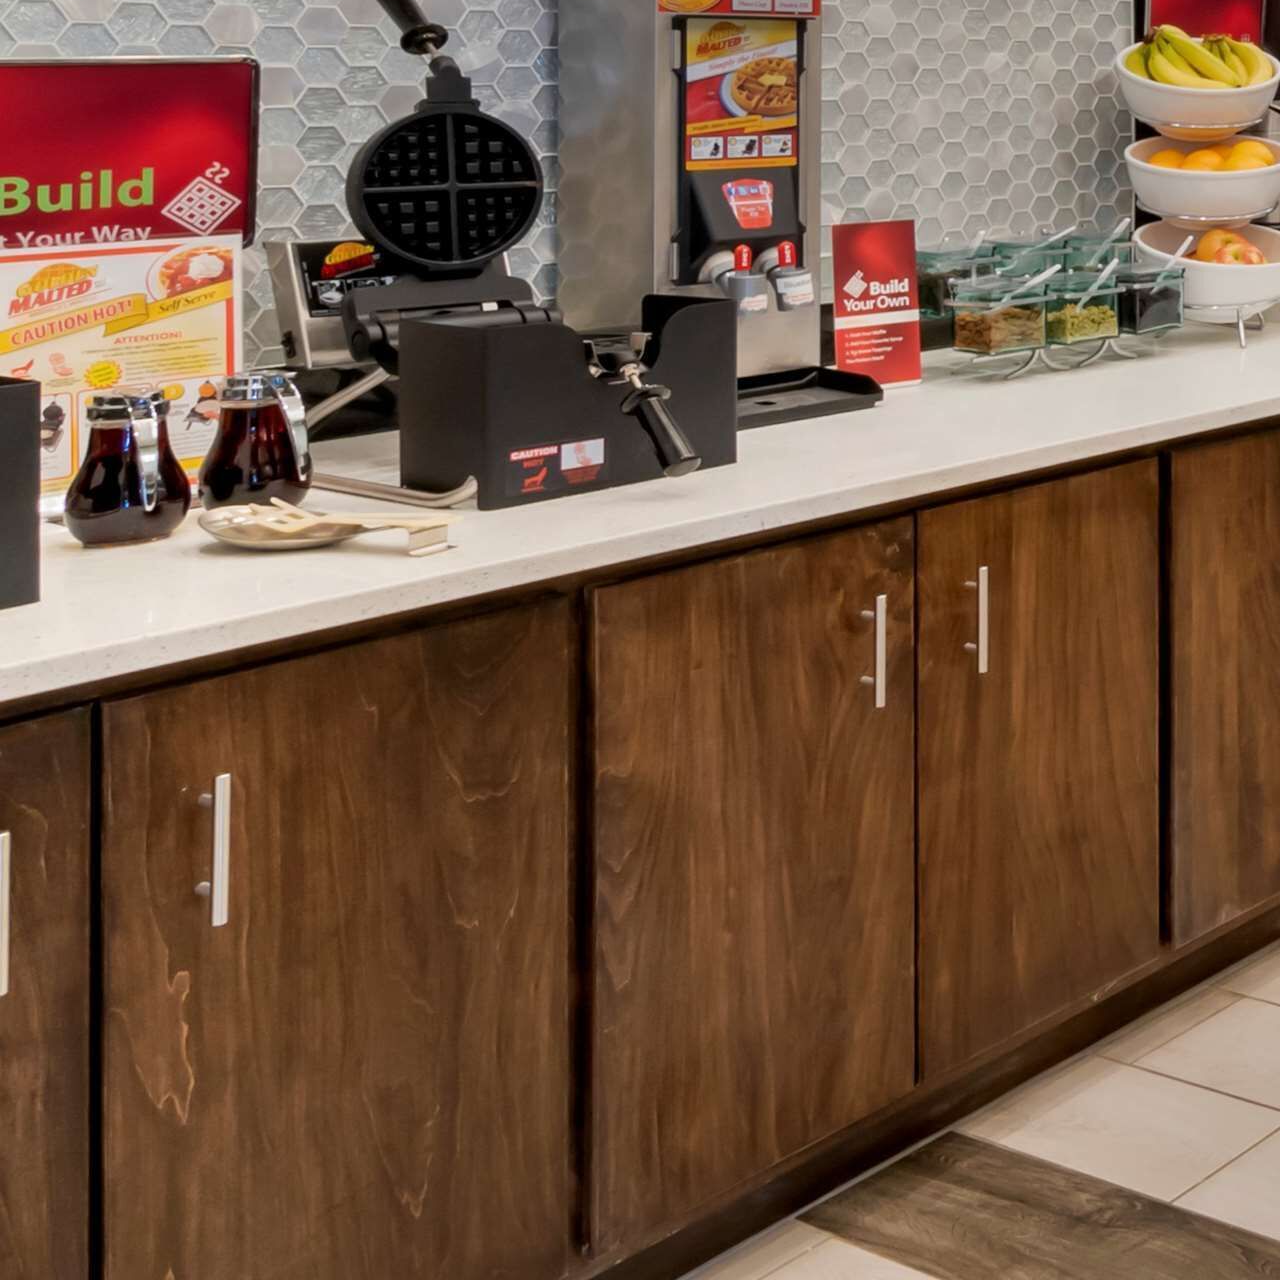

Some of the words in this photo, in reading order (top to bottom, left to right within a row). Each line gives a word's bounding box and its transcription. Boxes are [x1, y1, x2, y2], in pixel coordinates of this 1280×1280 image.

[0, 167, 154, 216] Build
[16, 231, 85, 247] Your
[91, 224, 152, 242] Way
[869, 278, 910, 296] Build
[8, 279, 93, 316] MALTED
[159, 299, 181, 313] Self
[843, 298, 875, 312] Your
[876, 295, 910, 308] Own
[11, 313, 89, 345] CAUTION
[93, 298, 132, 321] HOT!
[114, 331, 183, 345] ATTENTION!
[510, 446, 558, 461] CAUTION
